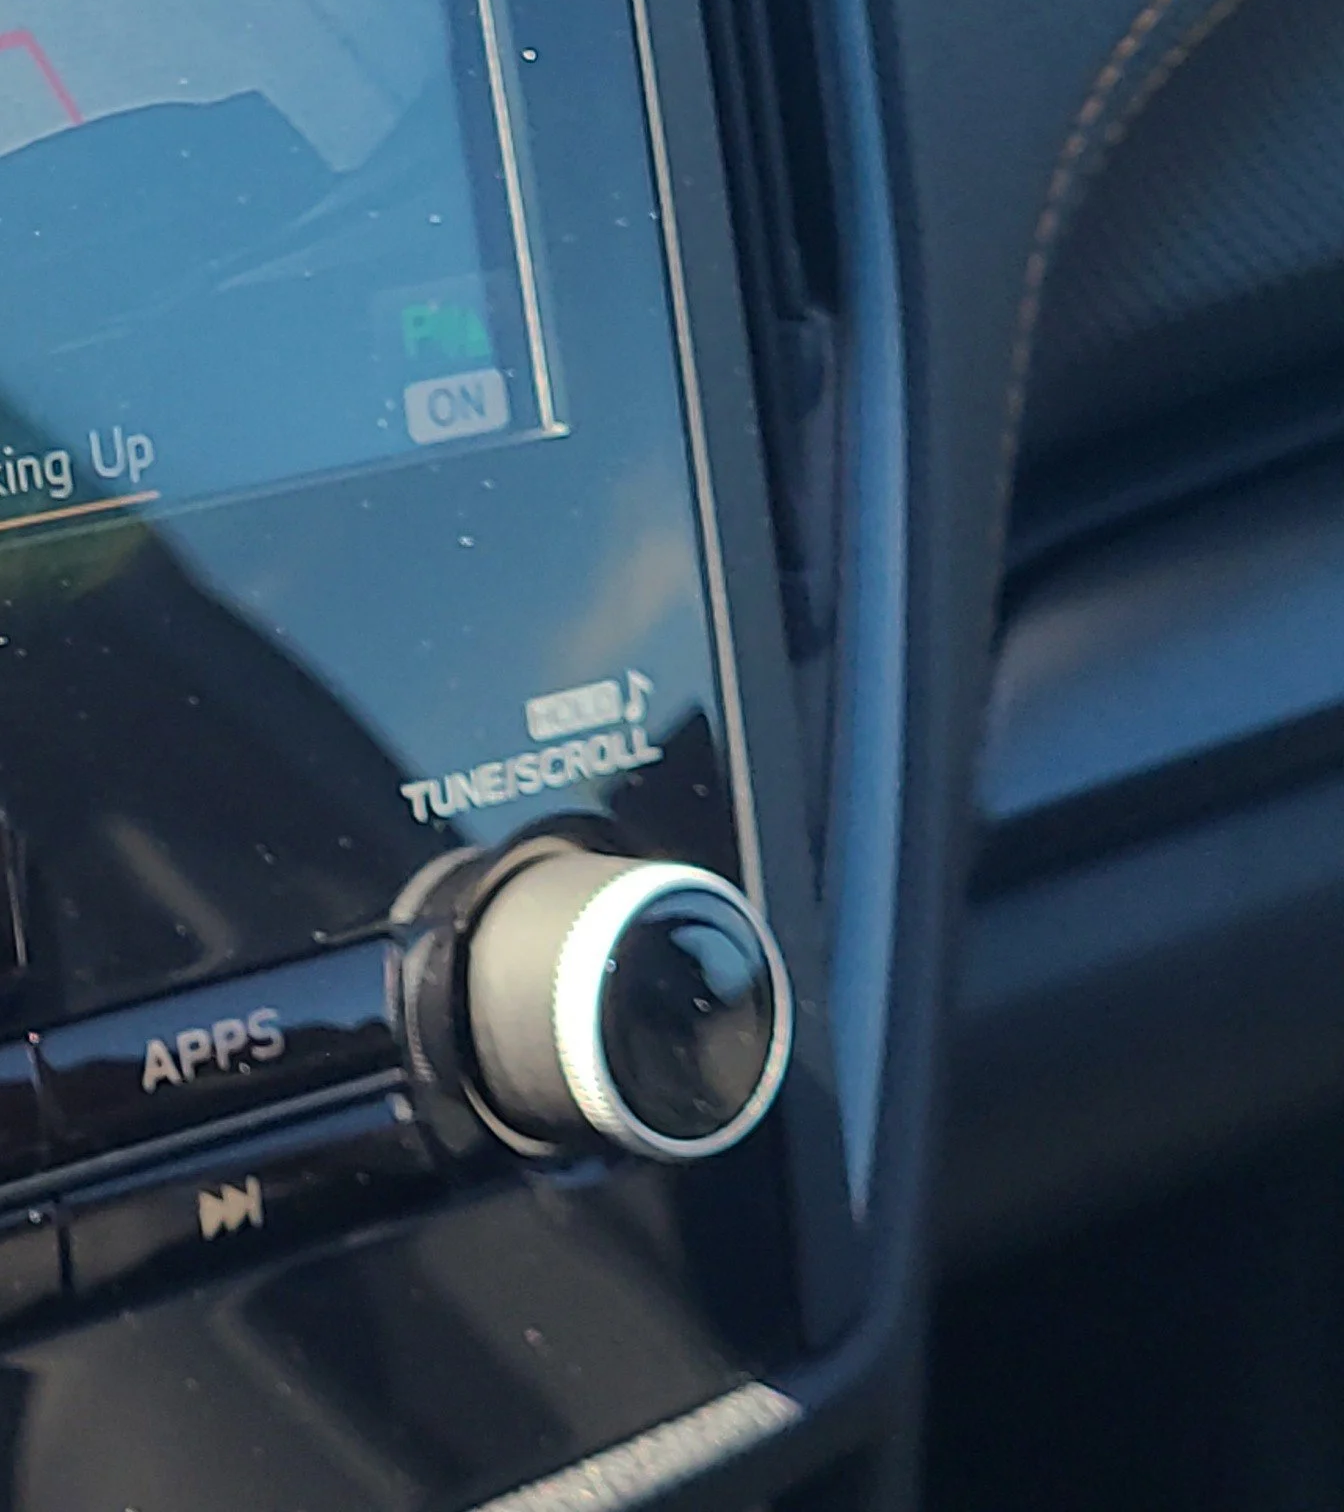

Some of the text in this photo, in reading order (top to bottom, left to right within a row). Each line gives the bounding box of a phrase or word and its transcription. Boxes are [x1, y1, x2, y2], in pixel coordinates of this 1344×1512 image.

[427, 383, 487, 428] ON
[87, 427, 156, 485] Up
[399, 726, 664, 824] TUNE/SCROLL
[139, 1008, 288, 1094] APPS
